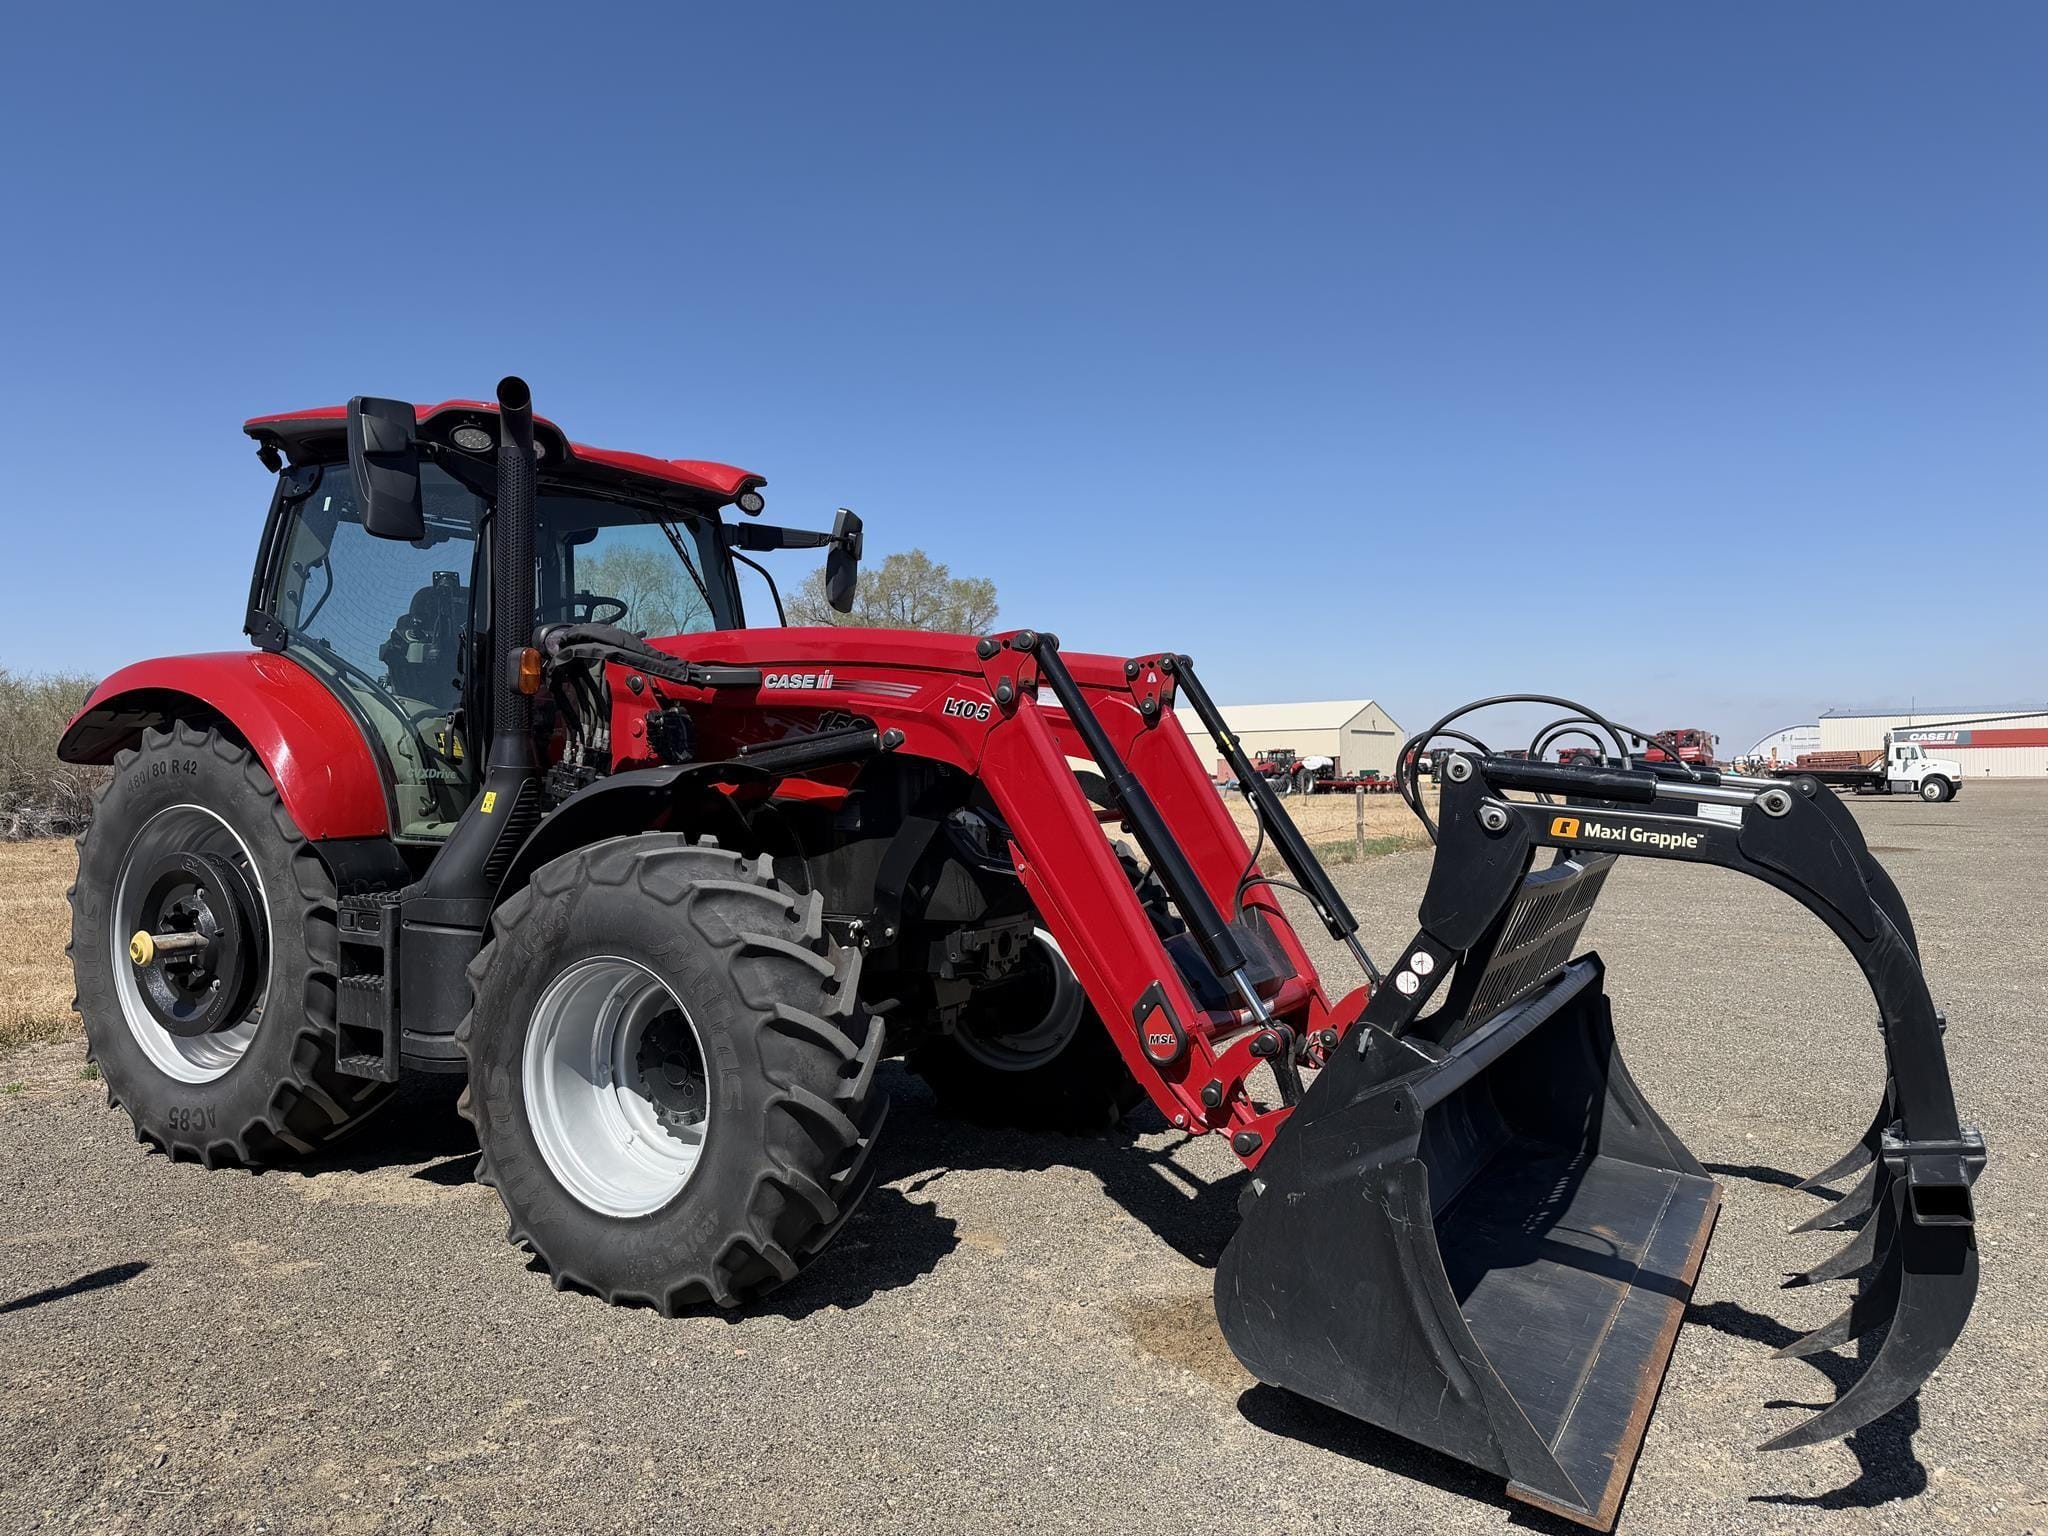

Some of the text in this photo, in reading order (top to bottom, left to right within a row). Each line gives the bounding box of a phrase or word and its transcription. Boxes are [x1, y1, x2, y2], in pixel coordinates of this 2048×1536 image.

[764, 674, 815, 689] CASE
[942, 696, 992, 721] L105
[1909, 732, 1946, 741] CASE
[126, 759, 198, 792] 480/80 R 42
[406, 768, 458, 779] CVXDrive
[1584, 822, 1626, 841] Maxi
[1149, 1033, 1175, 1045] MSL
[168, 1103, 217, 1132] AC85
